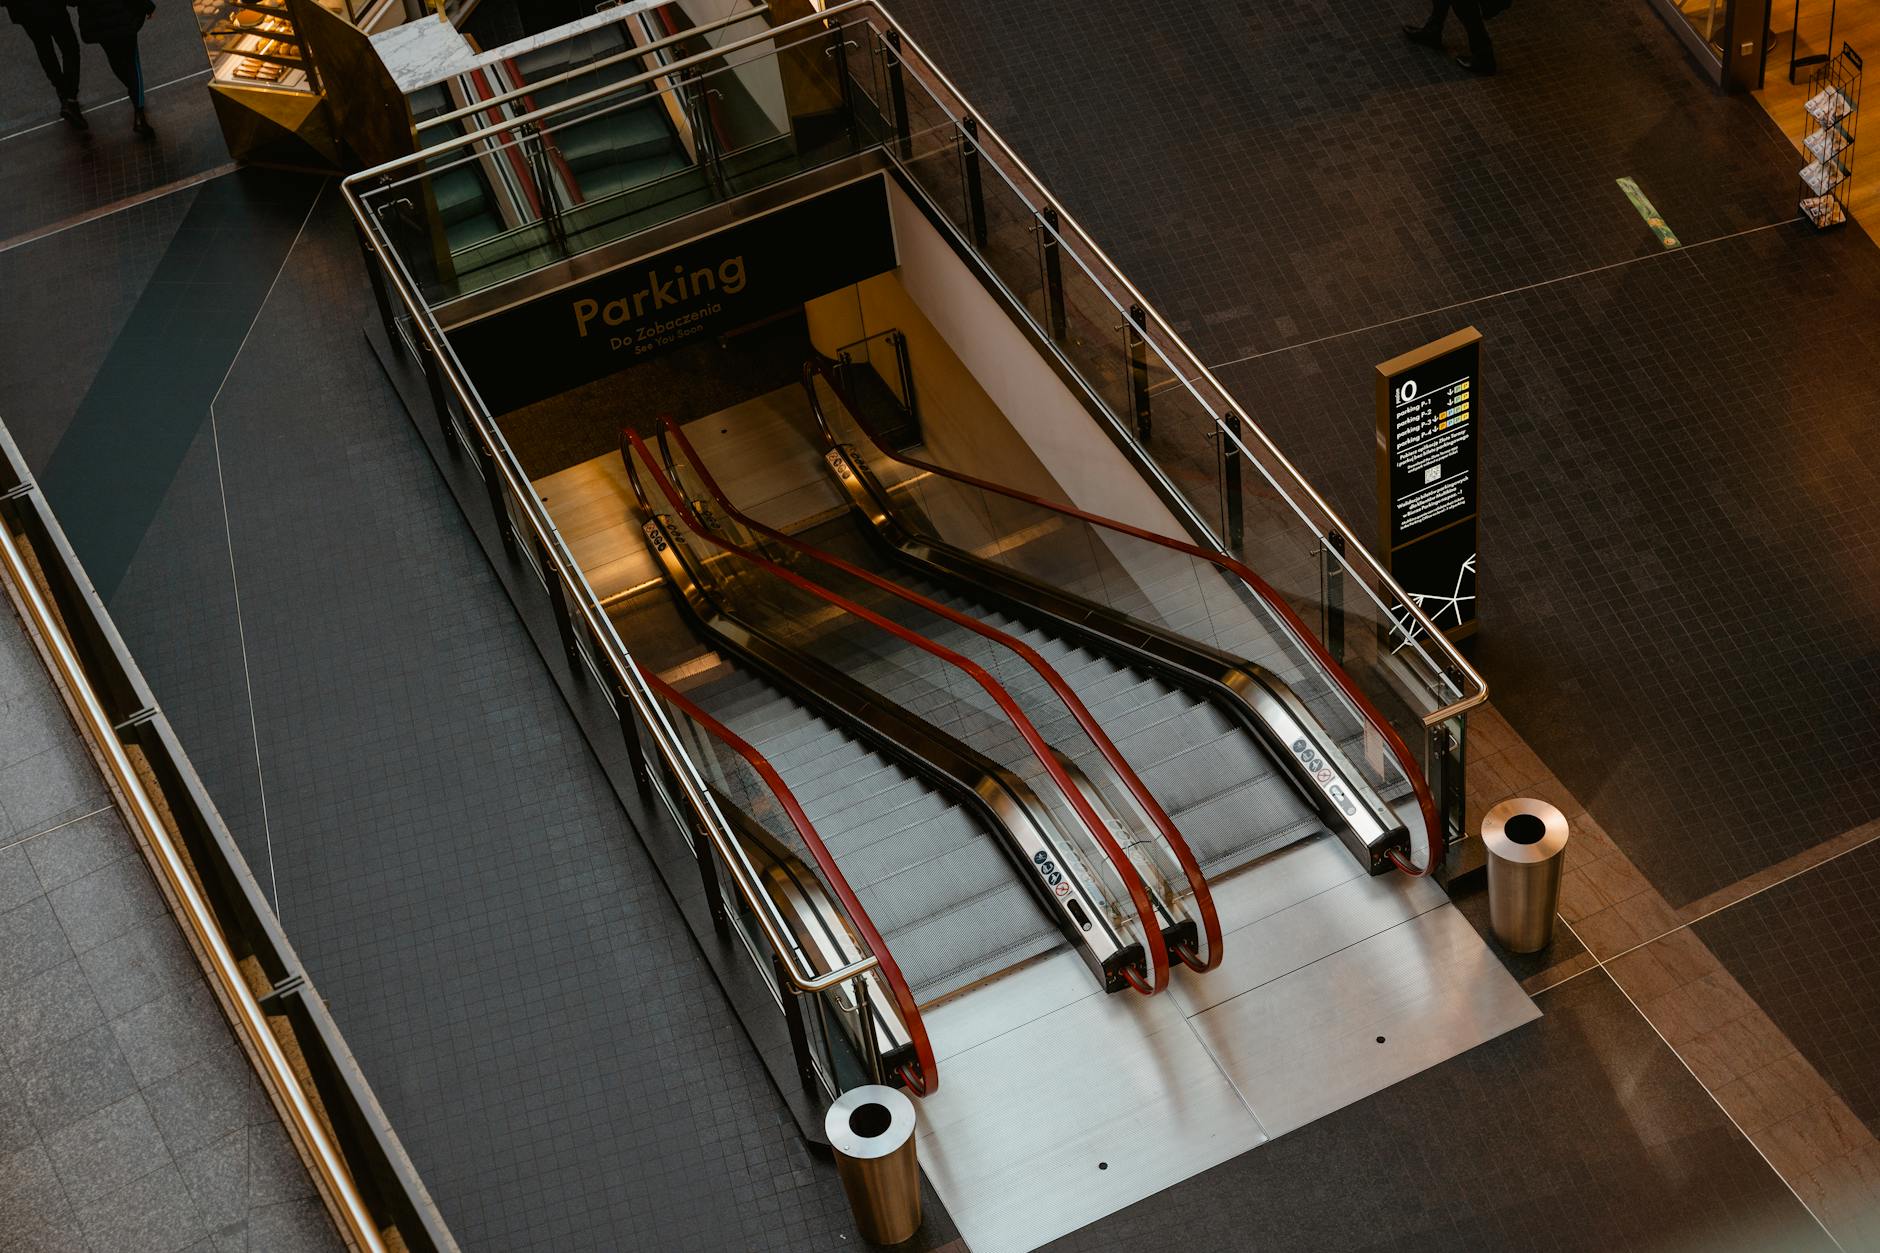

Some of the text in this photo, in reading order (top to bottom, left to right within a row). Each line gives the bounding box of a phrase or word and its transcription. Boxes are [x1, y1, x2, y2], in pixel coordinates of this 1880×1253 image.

[572, 255, 747, 337] Parking
[609, 303, 722, 351] Do Zobaczenia
[634, 324, 704, 355] See You Soon
[1396, 404, 1420, 419] parking
[1396, 414, 1420, 429] parking
[1396, 425, 1420, 440] parking
[1396, 435, 1420, 450] parking
